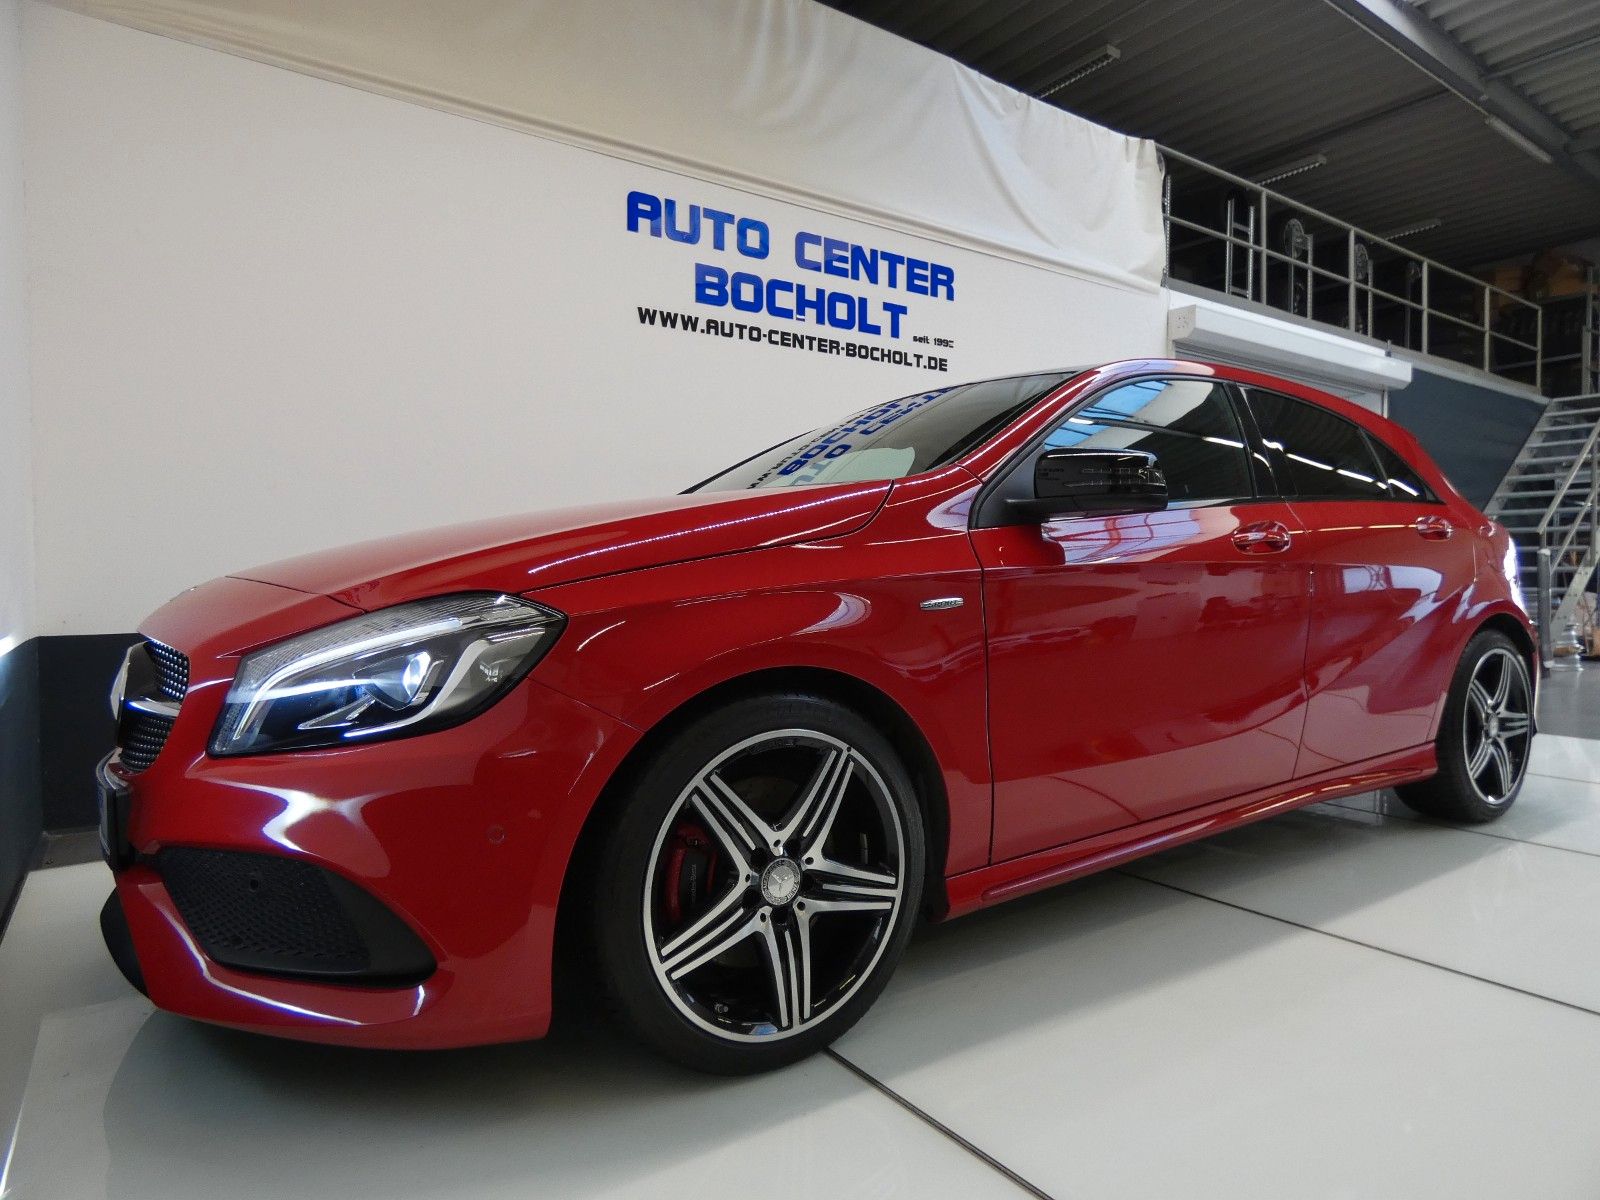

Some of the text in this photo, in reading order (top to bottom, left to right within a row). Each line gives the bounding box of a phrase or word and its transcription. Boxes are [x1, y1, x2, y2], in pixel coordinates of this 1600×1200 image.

[627, 191, 955, 301] AUTO CENTER
[695, 263, 907, 338] BOCHOLT
[638, 307, 948, 372] WWW.AUTO-CENTER-BOCHOLT.DE
[913, 336, 929, 344] seit
